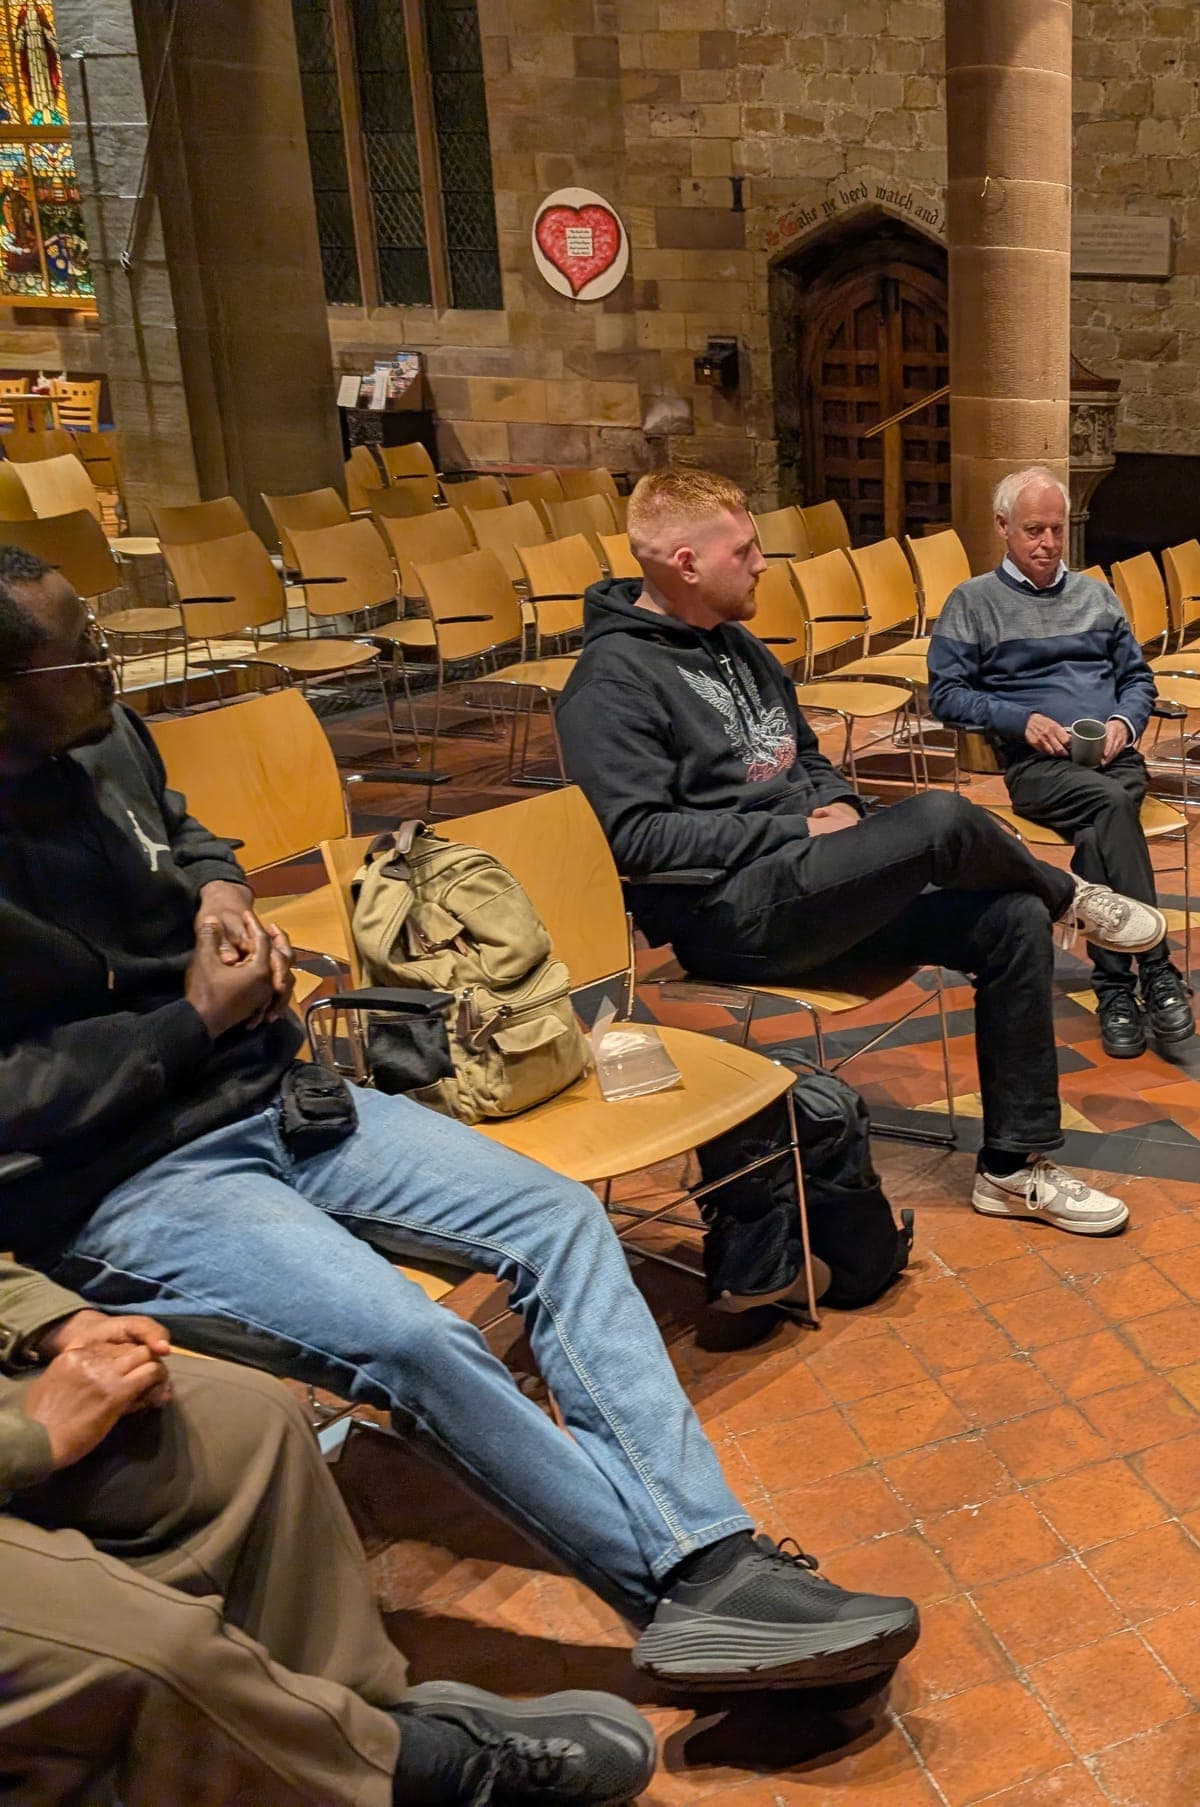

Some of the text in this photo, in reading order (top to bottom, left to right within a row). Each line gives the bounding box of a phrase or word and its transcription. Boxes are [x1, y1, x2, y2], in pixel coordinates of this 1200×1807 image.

[839, 182, 868, 205] heed
[875, 184, 913, 210] watch
[915, 206, 939, 225] and
